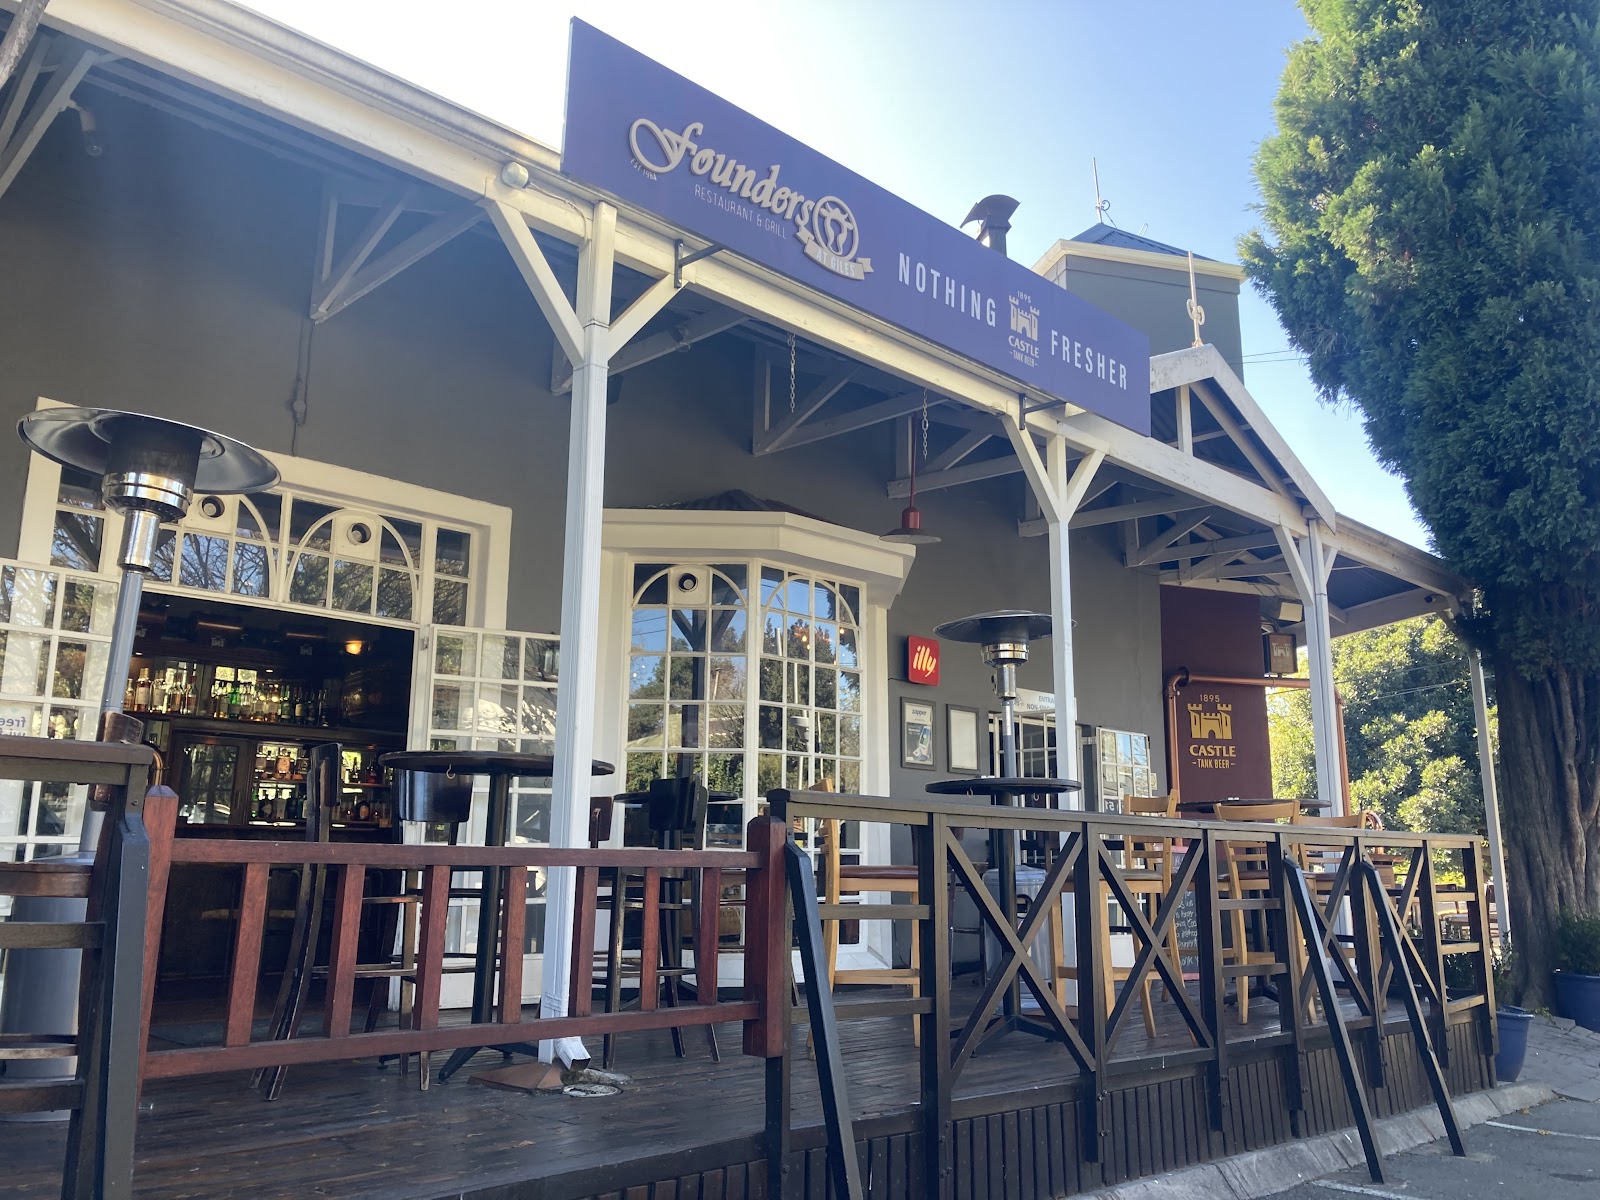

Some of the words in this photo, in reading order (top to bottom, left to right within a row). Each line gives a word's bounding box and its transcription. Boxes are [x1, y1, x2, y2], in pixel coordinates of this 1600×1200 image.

[630, 157, 642, 171] EST
[694, 183, 753, 222] RESTAURANT
[756, 213, 762, 227] &
[764, 217, 786, 239] GRILL
[816, 248, 828, 265] AT
[830, 256, 855, 277] GILES
[898, 252, 996, 328] NOTHING
[1017, 290, 1032, 304] 1895
[1008, 335, 1040, 359] CASTLE
[1013, 349, 1024, 363] TANK
[1024, 353, 1035, 368] BEER
[1051, 329, 1127, 390] FRESHER
[912, 645, 937, 678] illy
[1038, 695, 1055, 704] ENTRA
[1199, 694, 1220, 703] 1895
[1189, 744, 1237, 757] CASTLE
[1197, 758, 1213, 769] TANK
[1214, 759, 1230, 769] BEER
